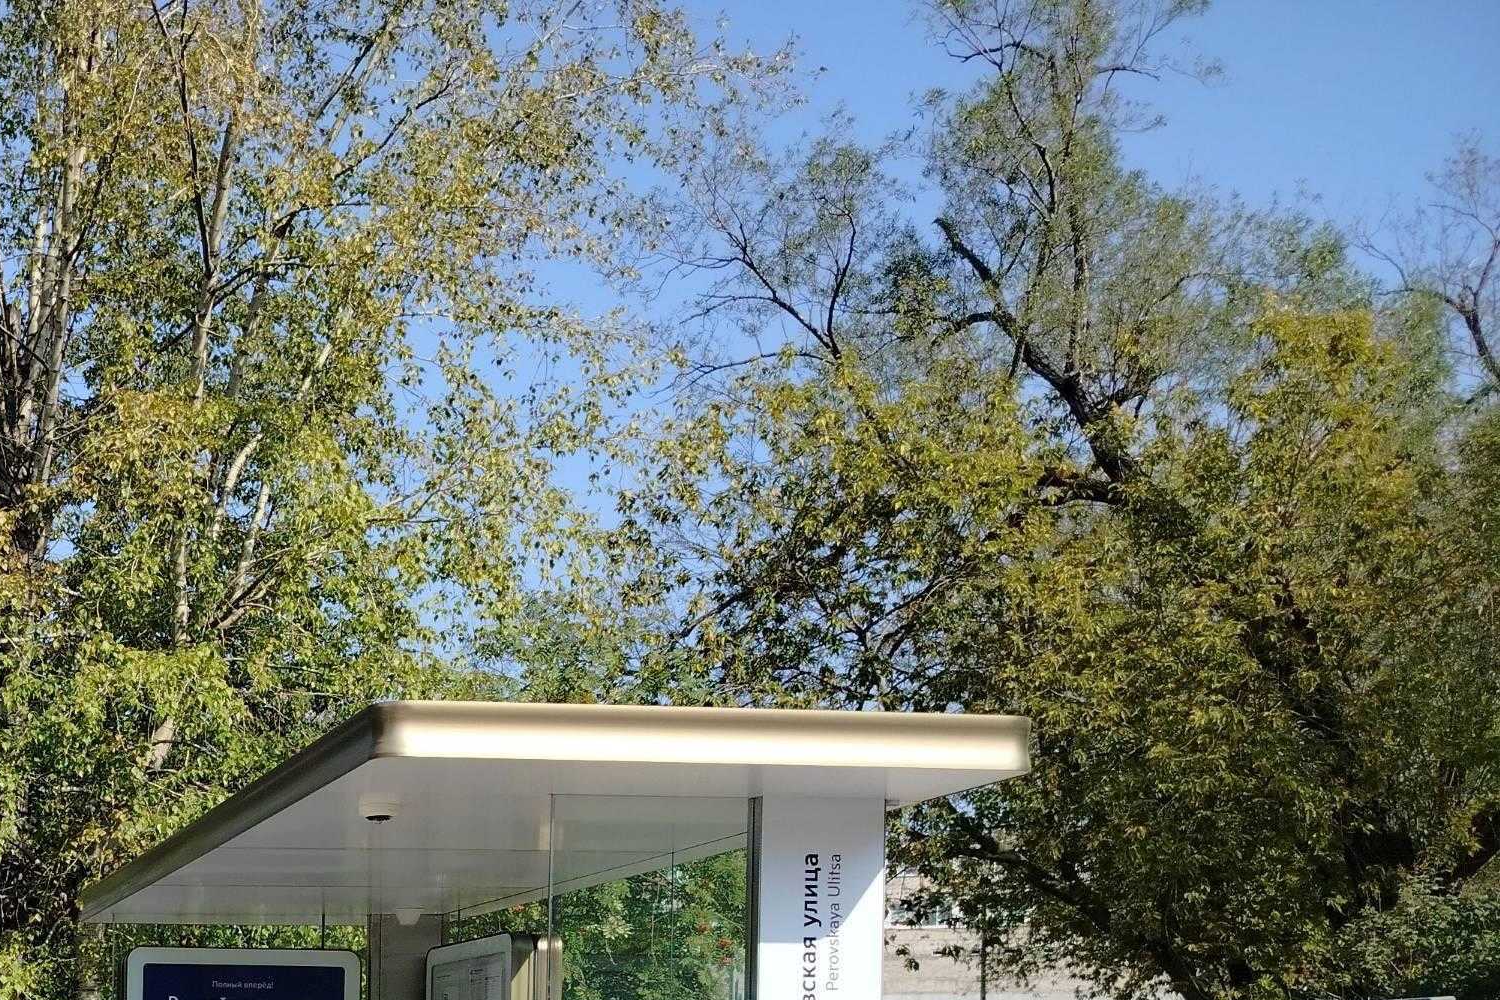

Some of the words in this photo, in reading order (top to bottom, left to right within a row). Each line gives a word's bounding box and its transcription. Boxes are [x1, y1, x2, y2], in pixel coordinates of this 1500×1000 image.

[804, 853, 821, 927] улица
[827, 854, 842, 897] Ulitsa
[825, 902, 844, 991] Perovskaya
